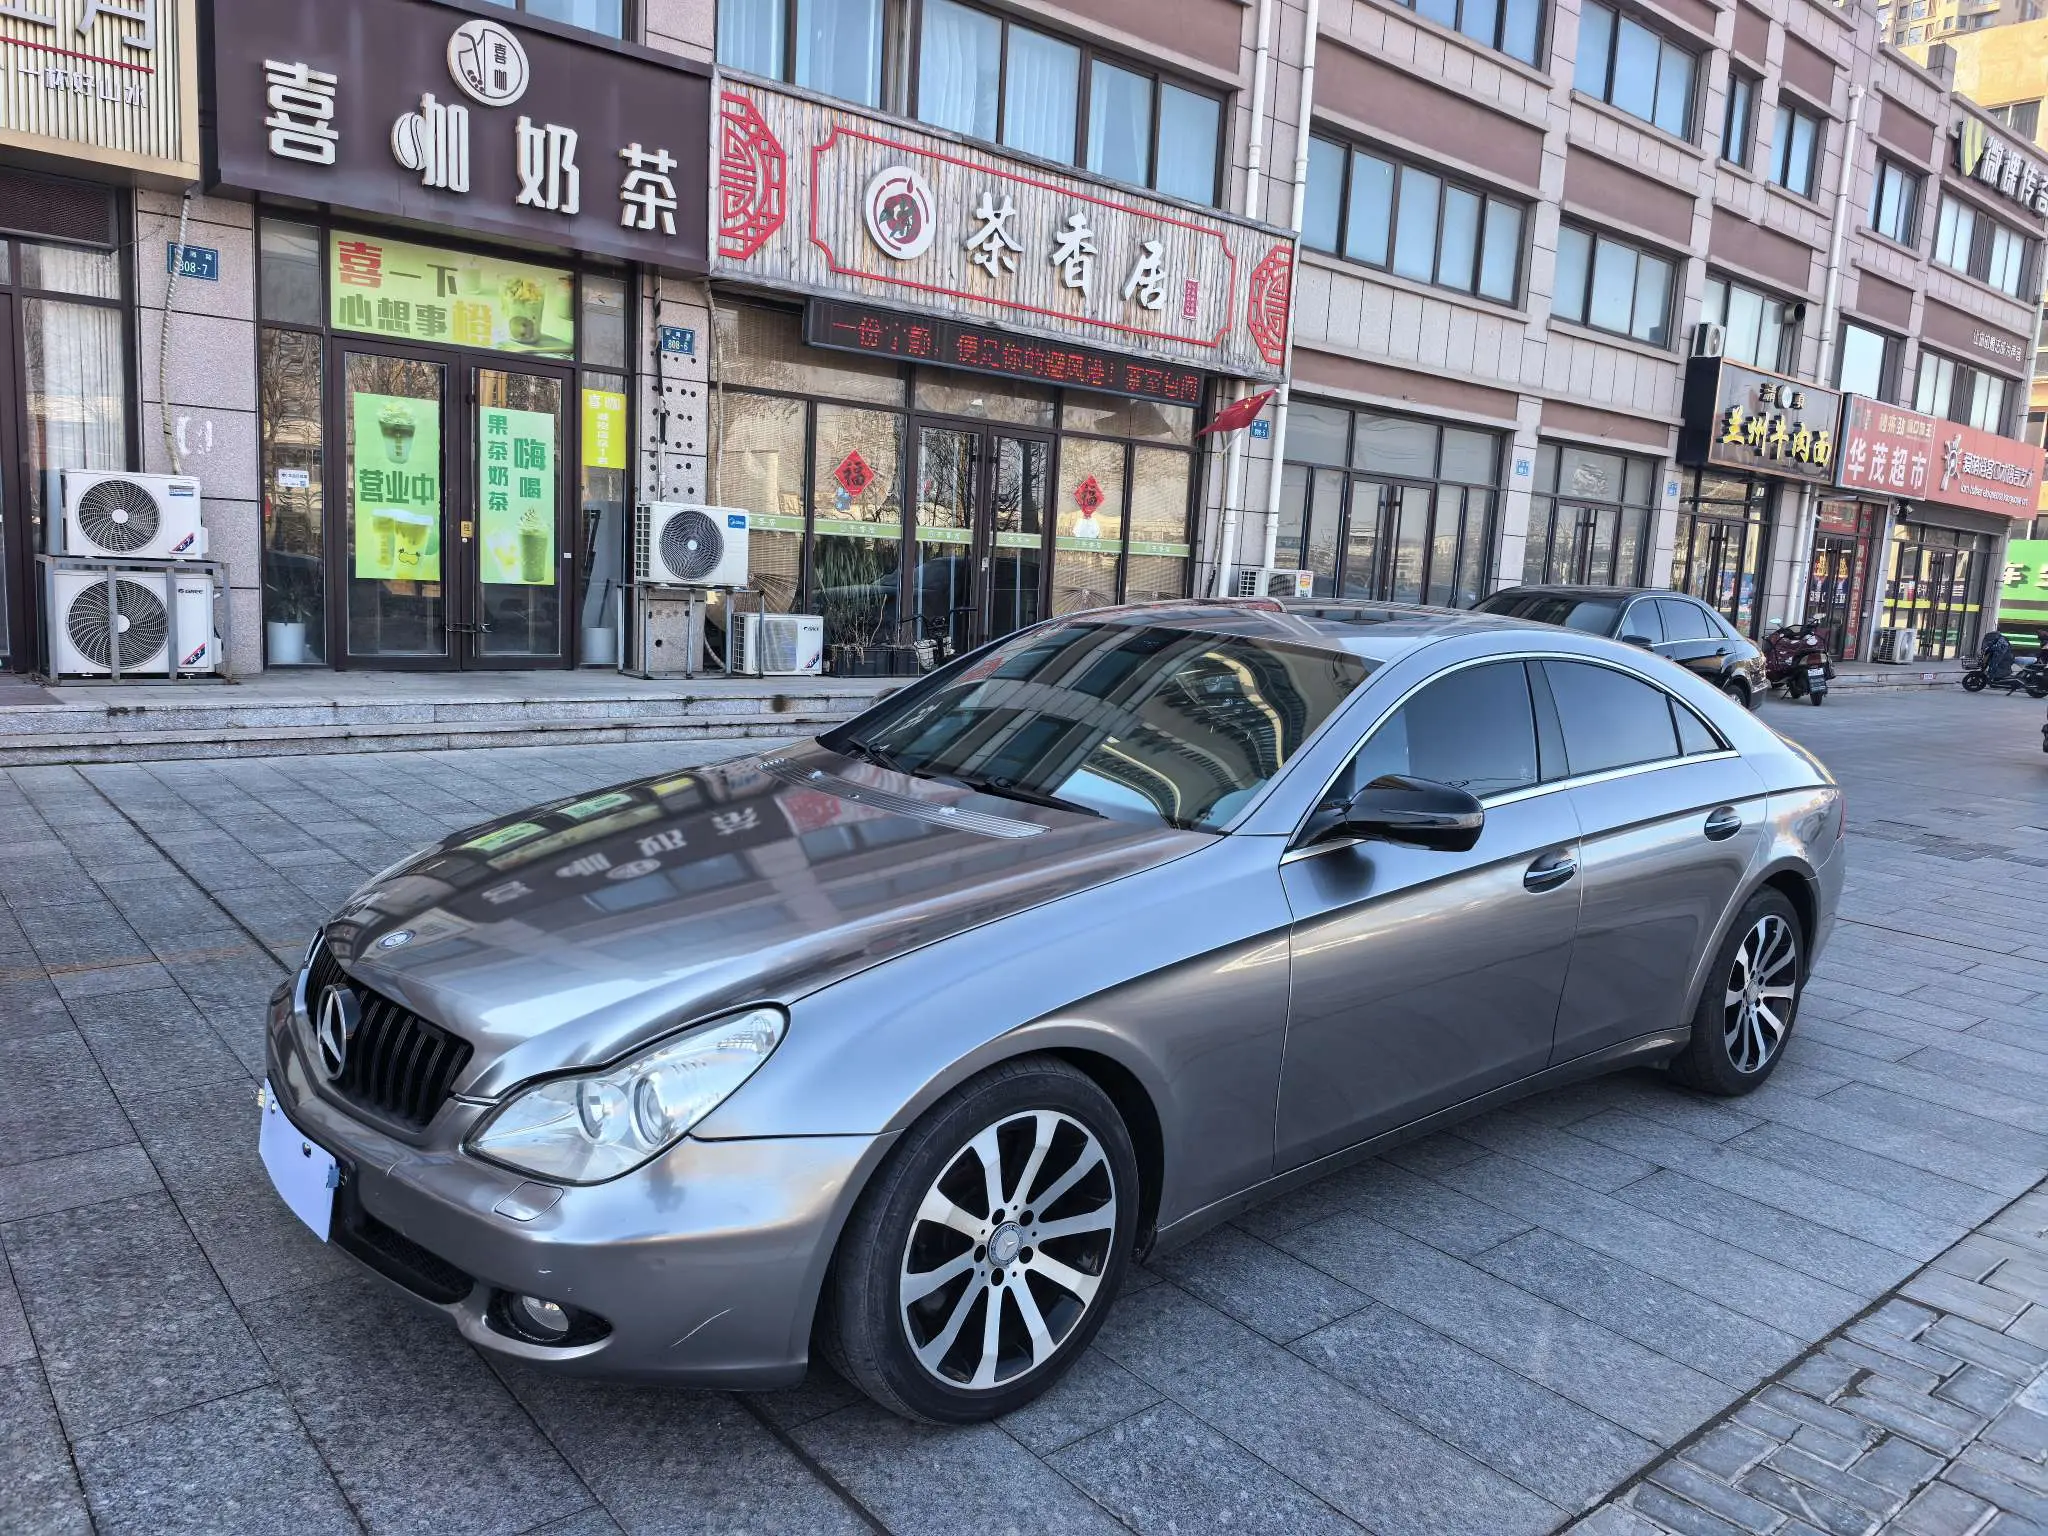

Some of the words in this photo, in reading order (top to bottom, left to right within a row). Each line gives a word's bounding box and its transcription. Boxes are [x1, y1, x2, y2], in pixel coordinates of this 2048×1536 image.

[337, 241, 459, 298] 喜一下
[966, 191, 1169, 310] 茶香居
[359, 468, 435, 506] 营业中
[487, 413, 510, 513] 果茶奶茶
[513, 437, 547, 500] 嗨喝
[1847, 436, 1928, 493] 华茂超市
